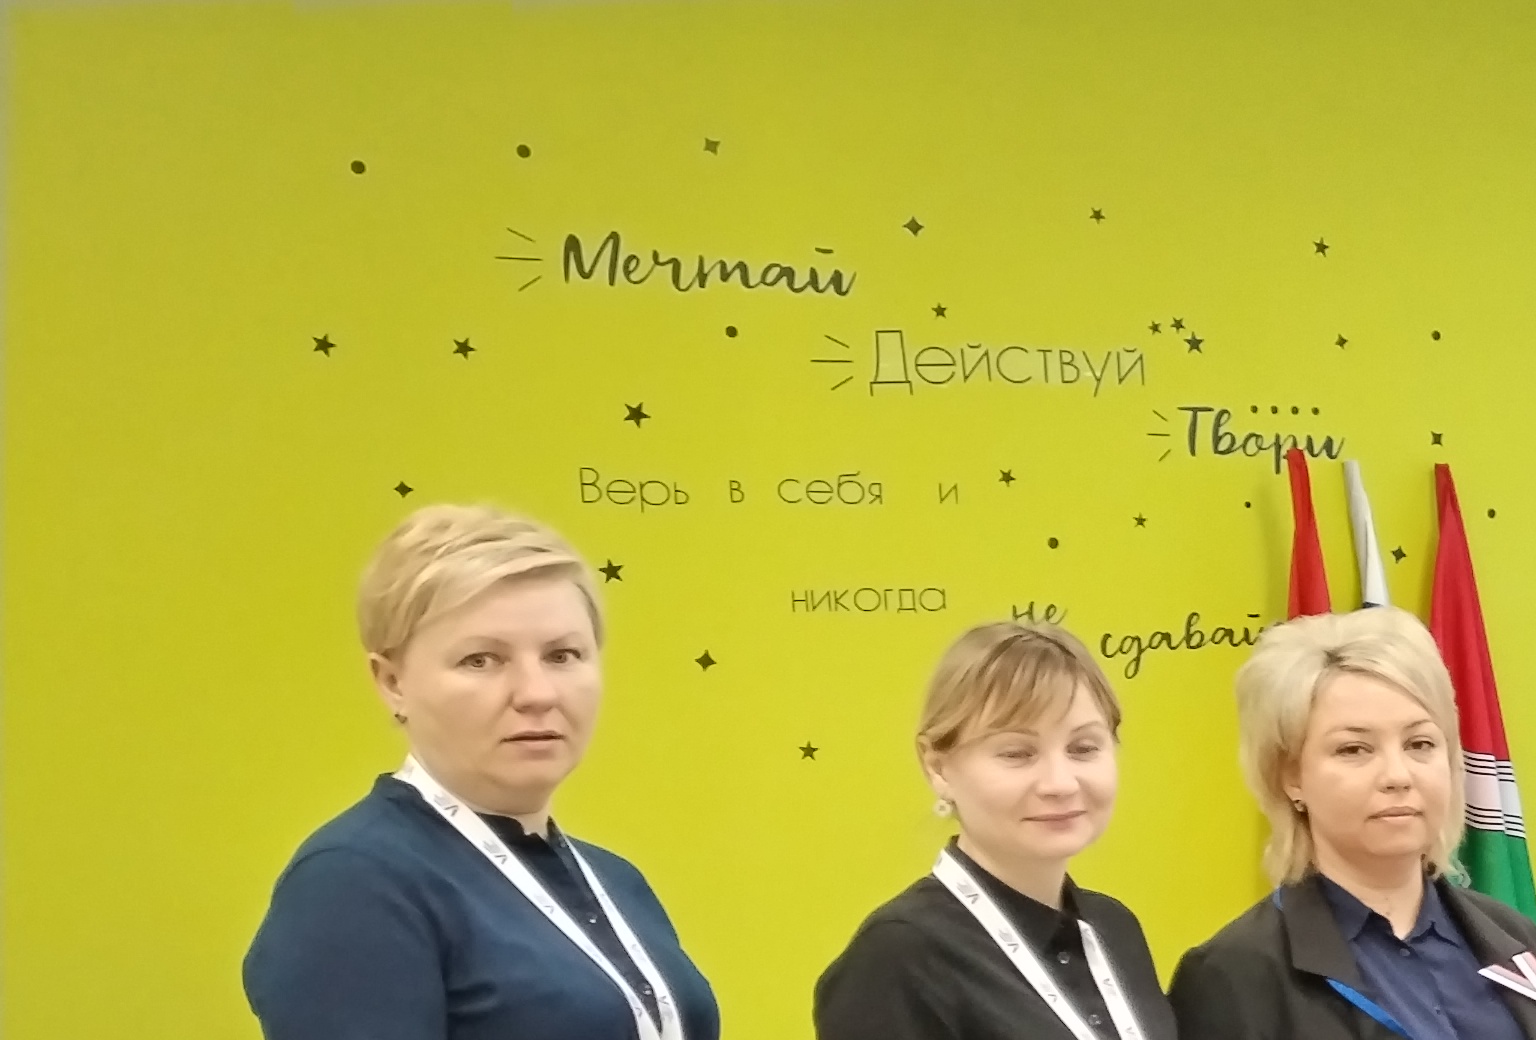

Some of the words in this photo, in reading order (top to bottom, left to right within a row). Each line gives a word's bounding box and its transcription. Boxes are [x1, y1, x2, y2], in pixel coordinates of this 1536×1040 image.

[563, 230, 857, 297] Мечтай
[869, 329, 1146, 397] Действуй
[1176, 405, 1346, 475] Твори
[578, 466, 690, 513] Верь
[776, 471, 884, 506] себя
[938, 481, 959, 505] и
[790, 587, 947, 613] никогда
